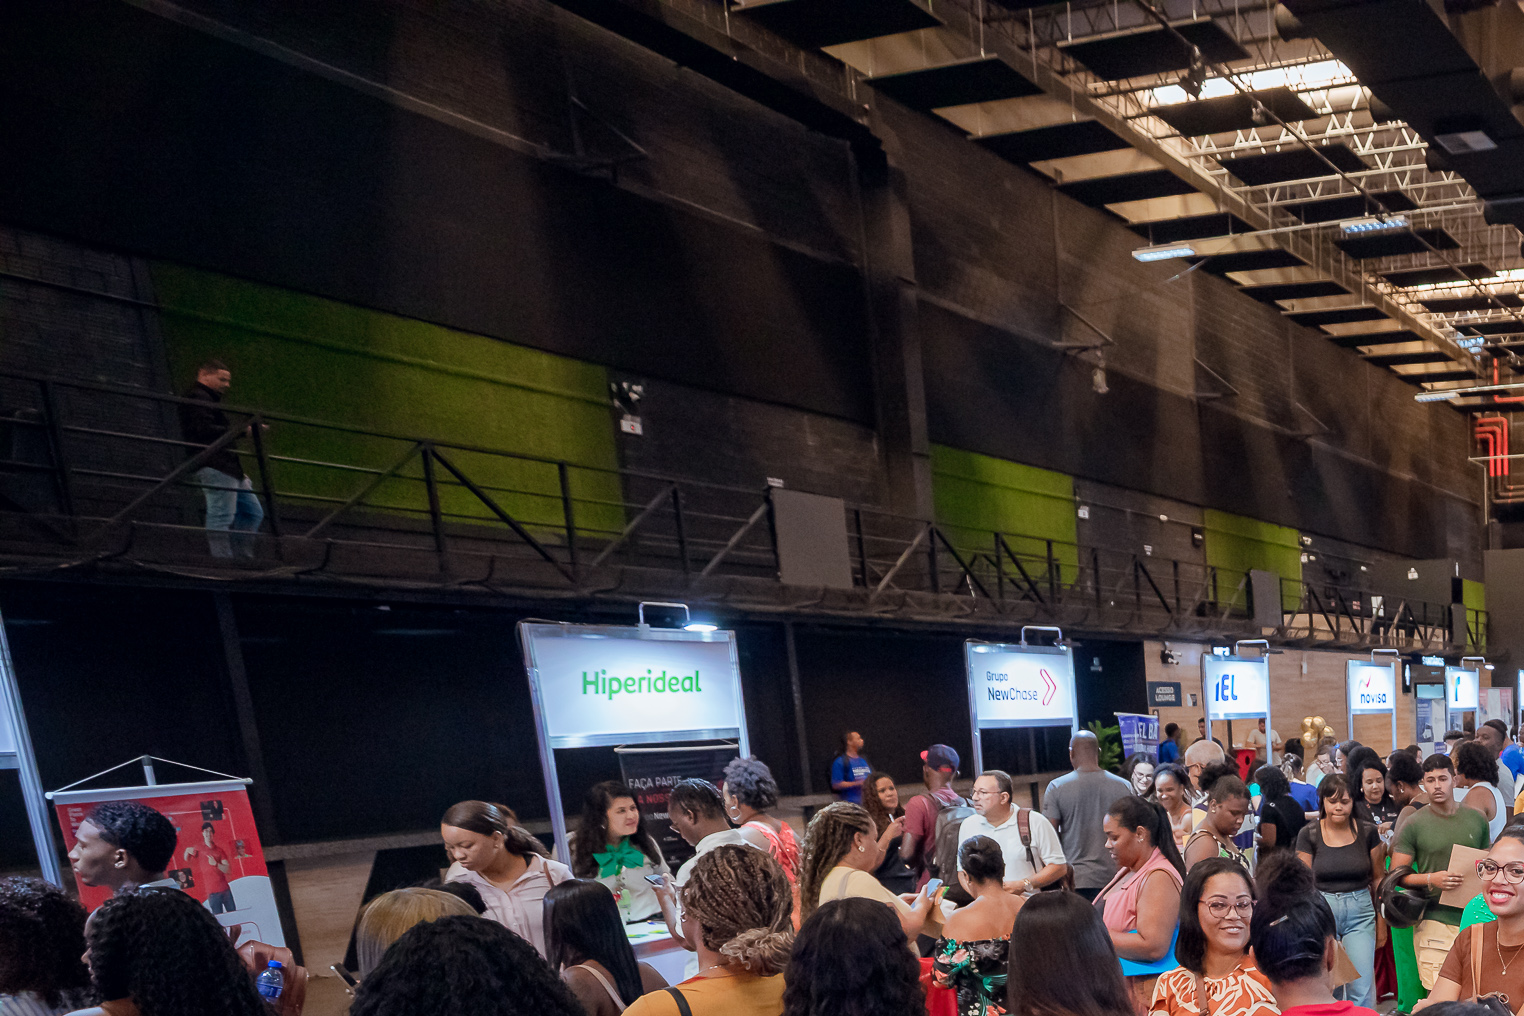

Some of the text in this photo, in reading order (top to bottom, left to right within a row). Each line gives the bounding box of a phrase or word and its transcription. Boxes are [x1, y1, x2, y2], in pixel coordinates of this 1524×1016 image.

[986, 671, 1008, 682] Grupo
[582, 669, 702, 700] Hiperideal
[988, 687, 1038, 701] NewChase
[1360, 692, 1387, 704] novisa
[628, 778, 654, 791] FAÇA
[646, 792, 670, 804] NOSS
